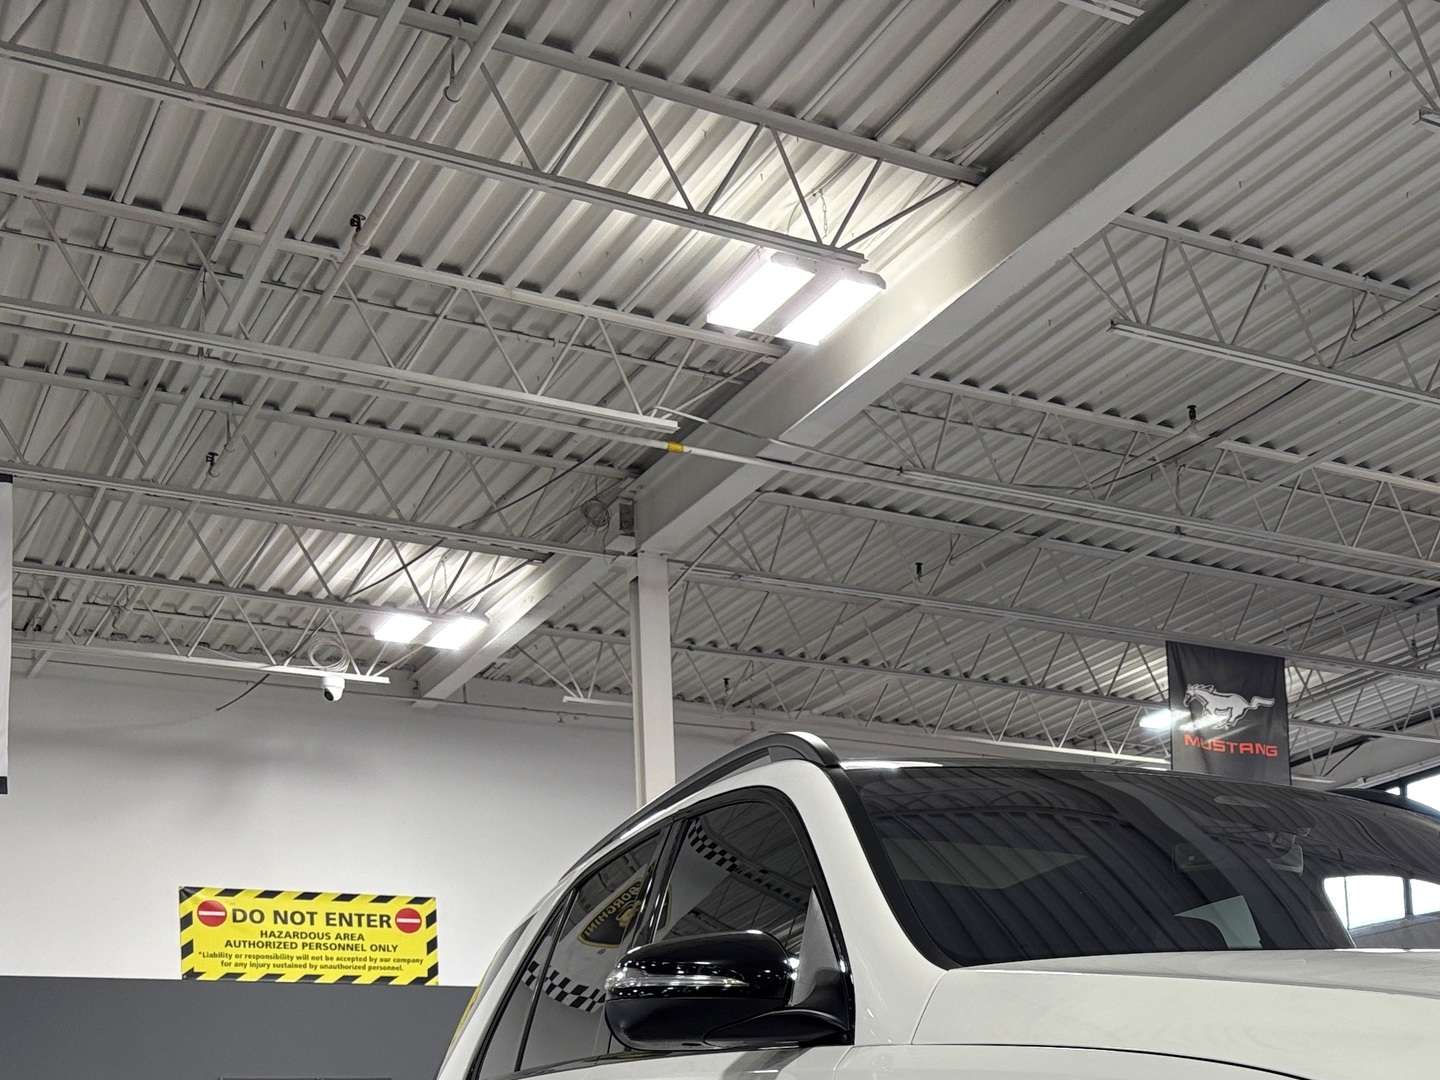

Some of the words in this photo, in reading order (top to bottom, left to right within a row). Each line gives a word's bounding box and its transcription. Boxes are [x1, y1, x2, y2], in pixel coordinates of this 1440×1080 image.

[1184, 733, 1278, 758] MUSTANG
[232, 908, 265, 924] DO
[273, 910, 318, 926] NOT
[325, 912, 392, 928] ENTER
[260, 930, 331, 940] HAZARDOUS
[335, 933, 365, 941] AREA
[225, 940, 298, 950] AUTHORIZED
[302, 942, 367, 952] PERSONNEL
[370, 944, 399, 953] ONLY
[244, 952, 294, 961] responsibility
[336, 955, 368, 963] accepted
[393, 958, 425, 966] company
[320, 962, 367, 970] unauthorized
